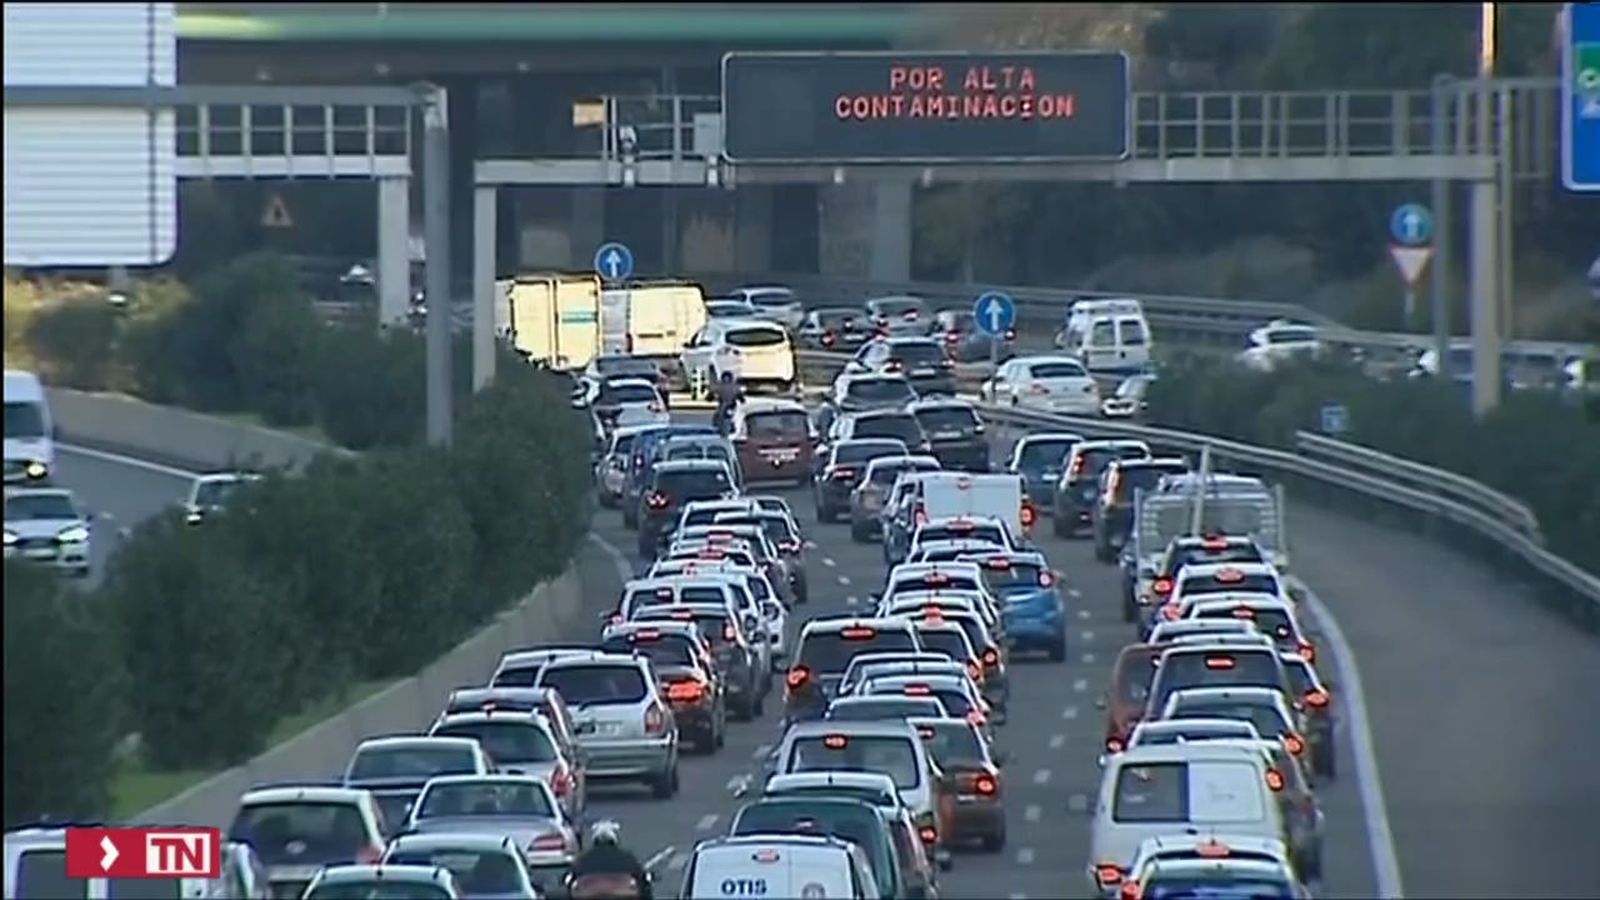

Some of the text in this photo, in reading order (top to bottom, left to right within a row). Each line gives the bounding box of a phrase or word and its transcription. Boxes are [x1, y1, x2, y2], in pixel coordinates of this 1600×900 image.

[890, 66, 1036, 90] POR ALTA
[835, 94, 1074, 119] CONTAMINACION
[721, 879, 767, 896] OTIS
